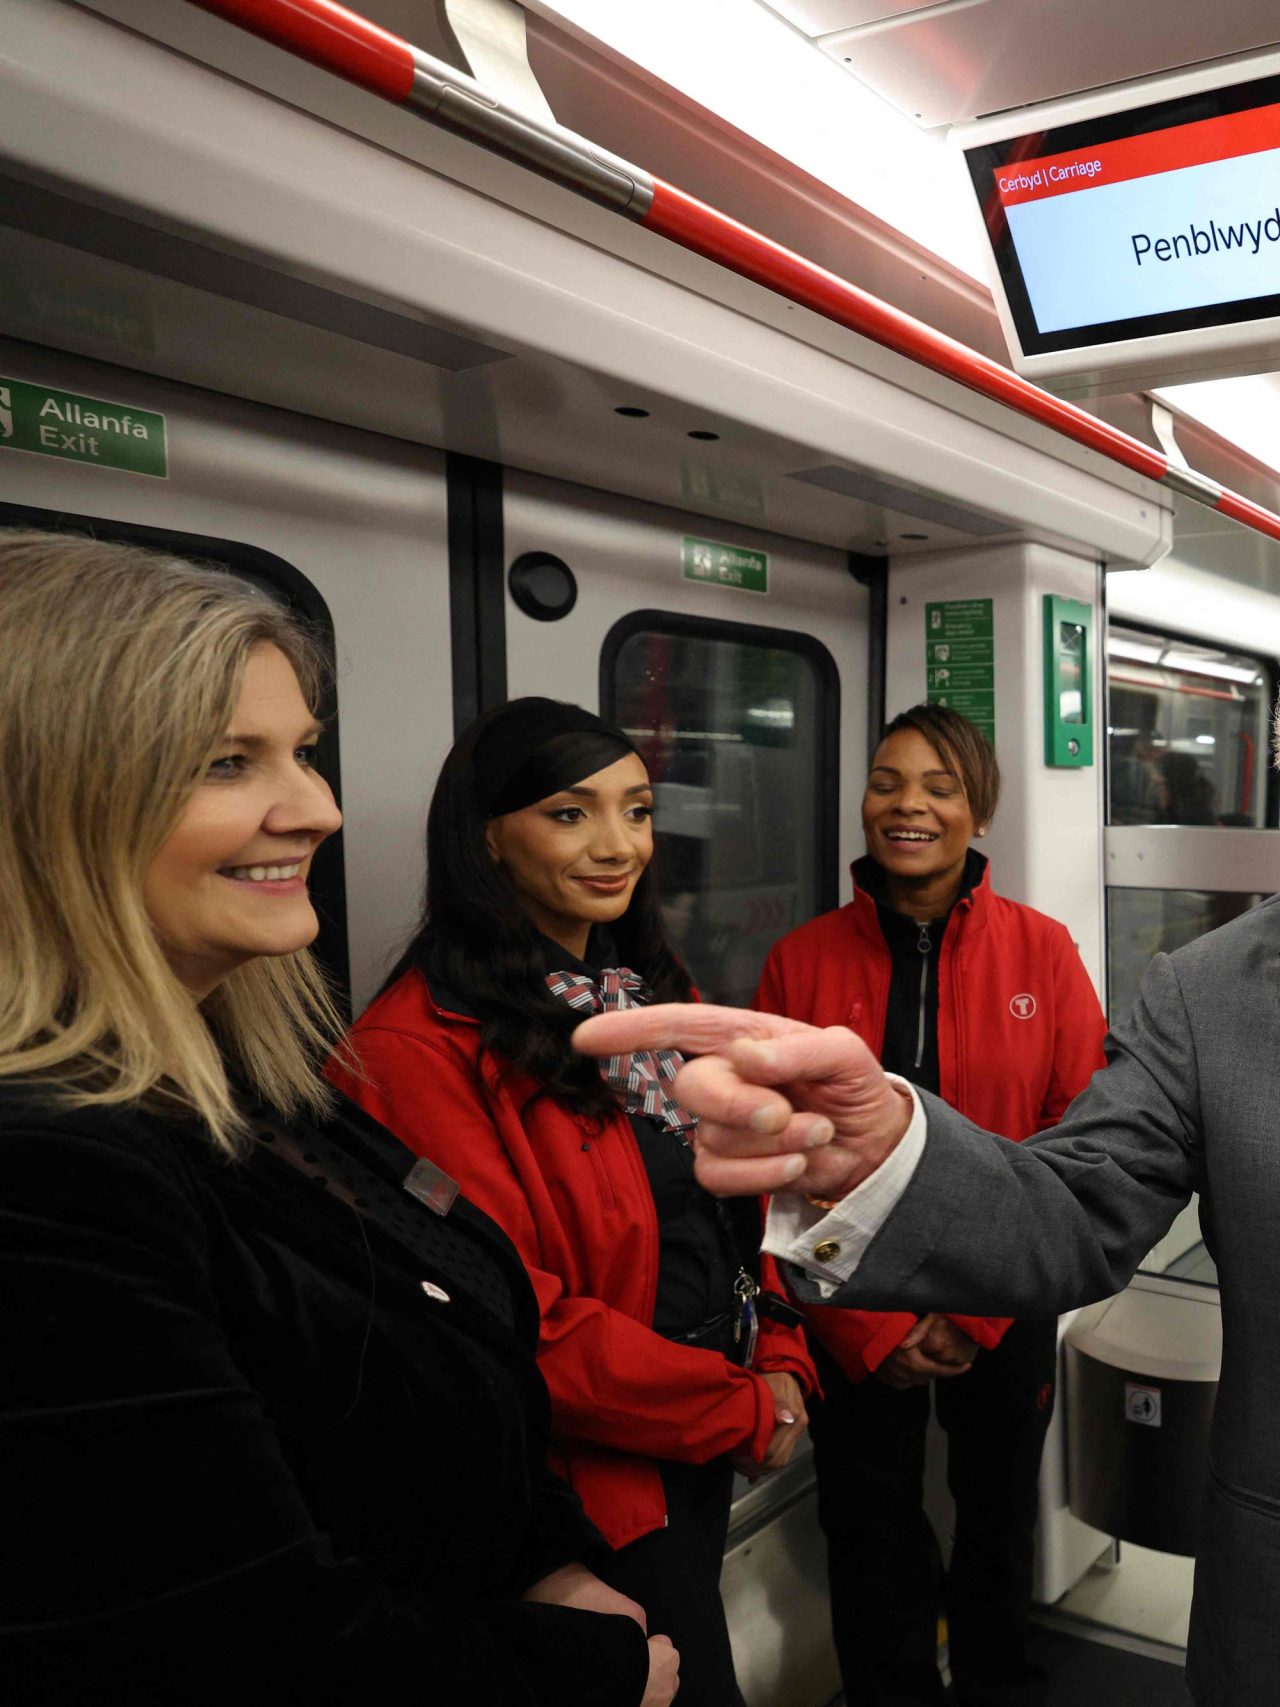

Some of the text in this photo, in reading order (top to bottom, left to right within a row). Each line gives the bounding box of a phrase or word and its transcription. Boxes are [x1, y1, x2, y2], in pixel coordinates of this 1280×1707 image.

[999, 170, 1042, 193] Cerbyd
[1049, 159, 1102, 182] Carriage
[39, 398, 149, 440] Allanfa
[39, 424, 101, 457] Exit
